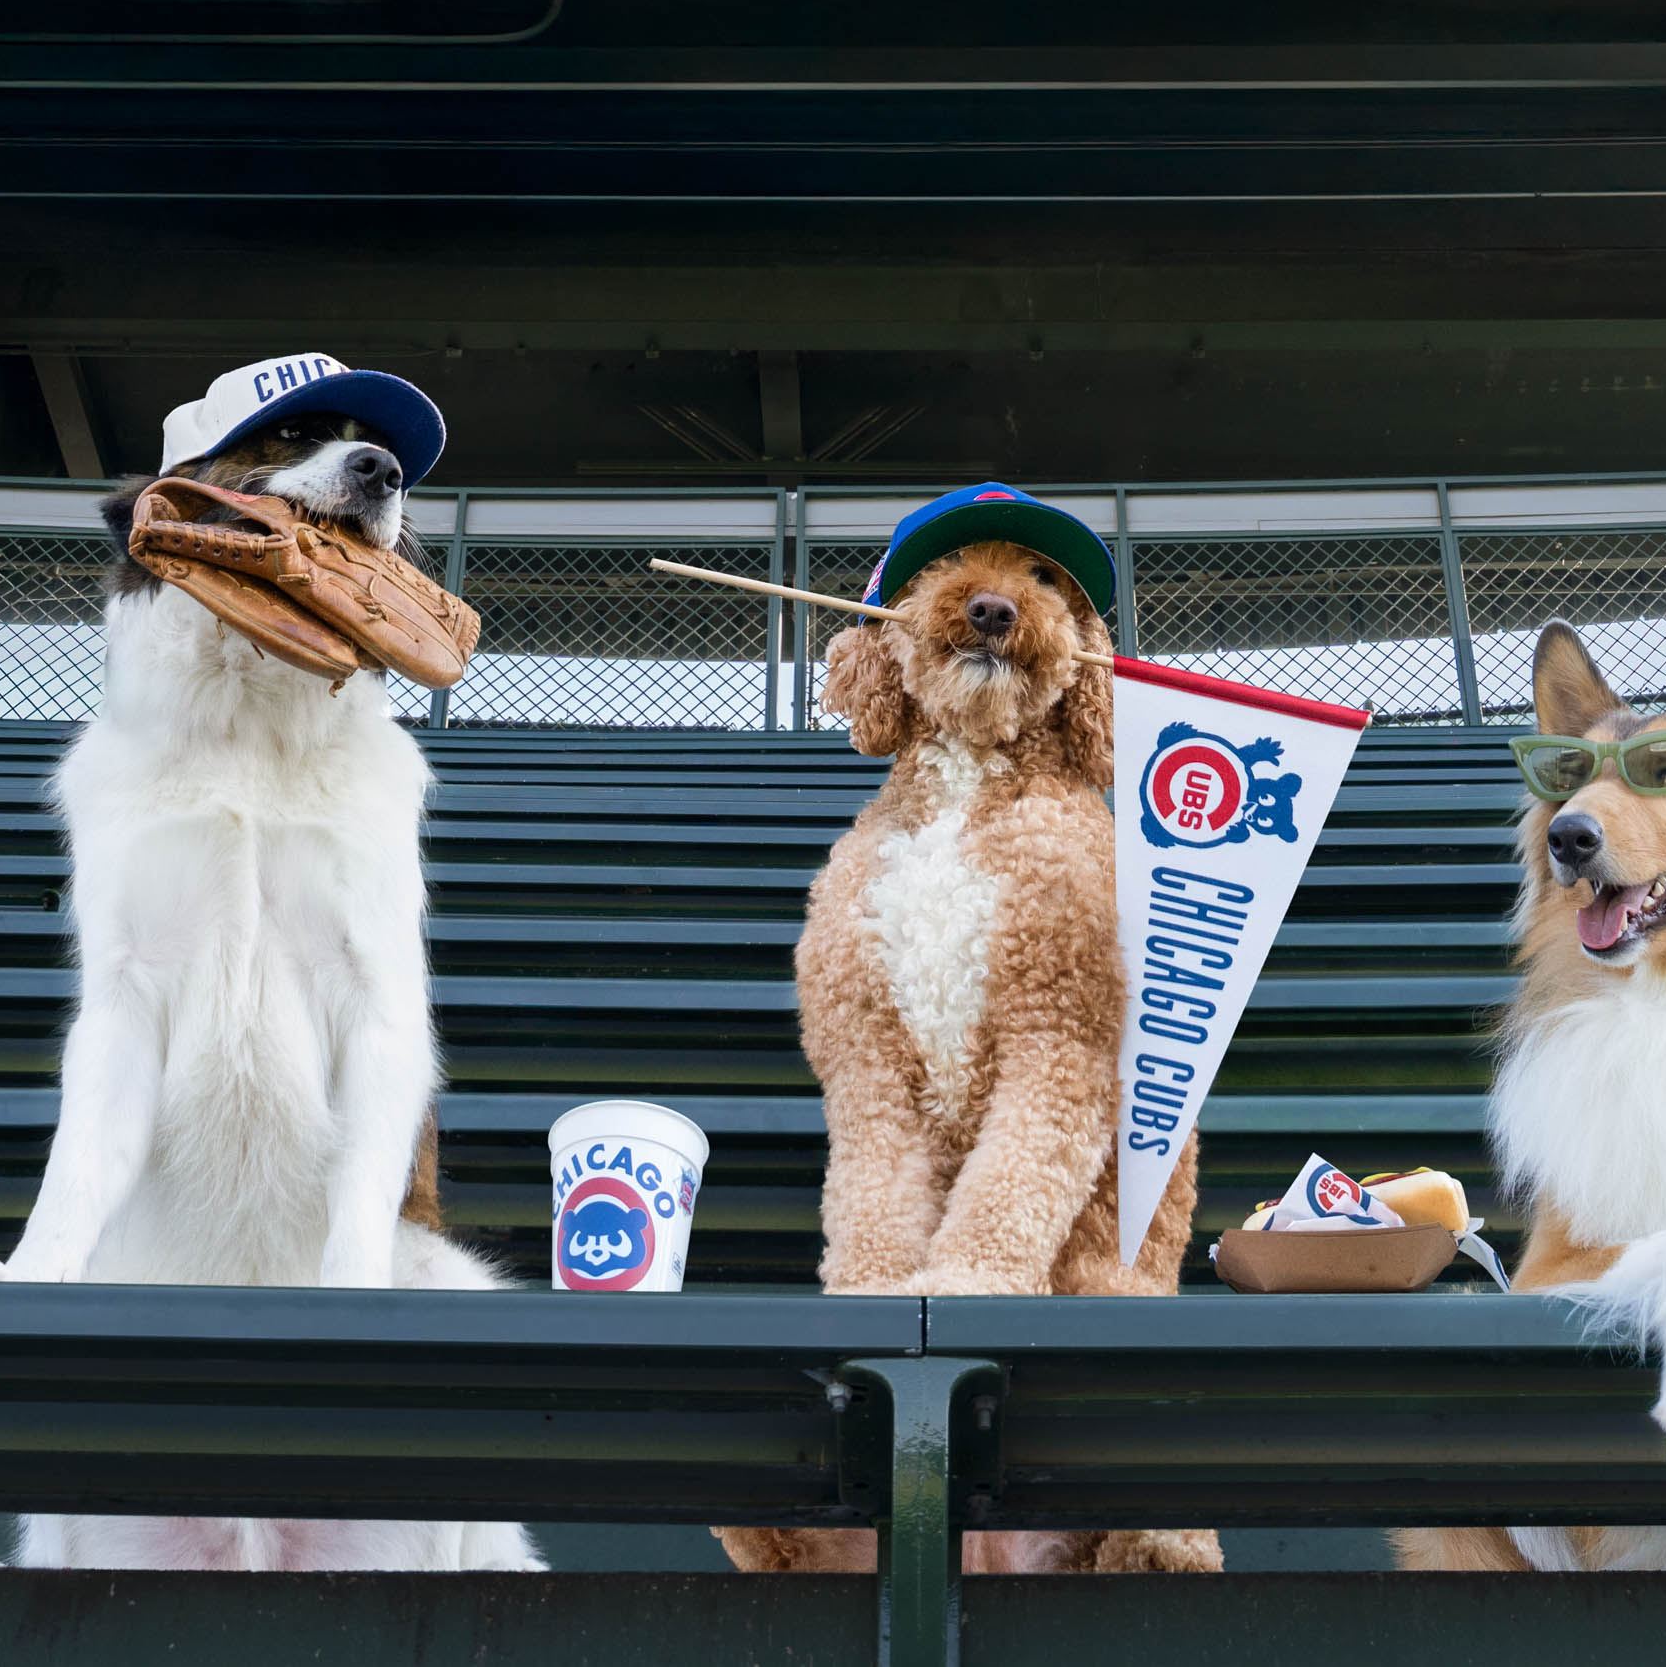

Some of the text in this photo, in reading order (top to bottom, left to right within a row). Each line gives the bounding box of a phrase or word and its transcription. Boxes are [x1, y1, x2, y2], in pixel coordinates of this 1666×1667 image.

[254, 358, 346, 403] CHIC
[1129, 866, 1255, 1157] CHICAGO CUBS
[552, 1143, 676, 1222] CHICAGO
